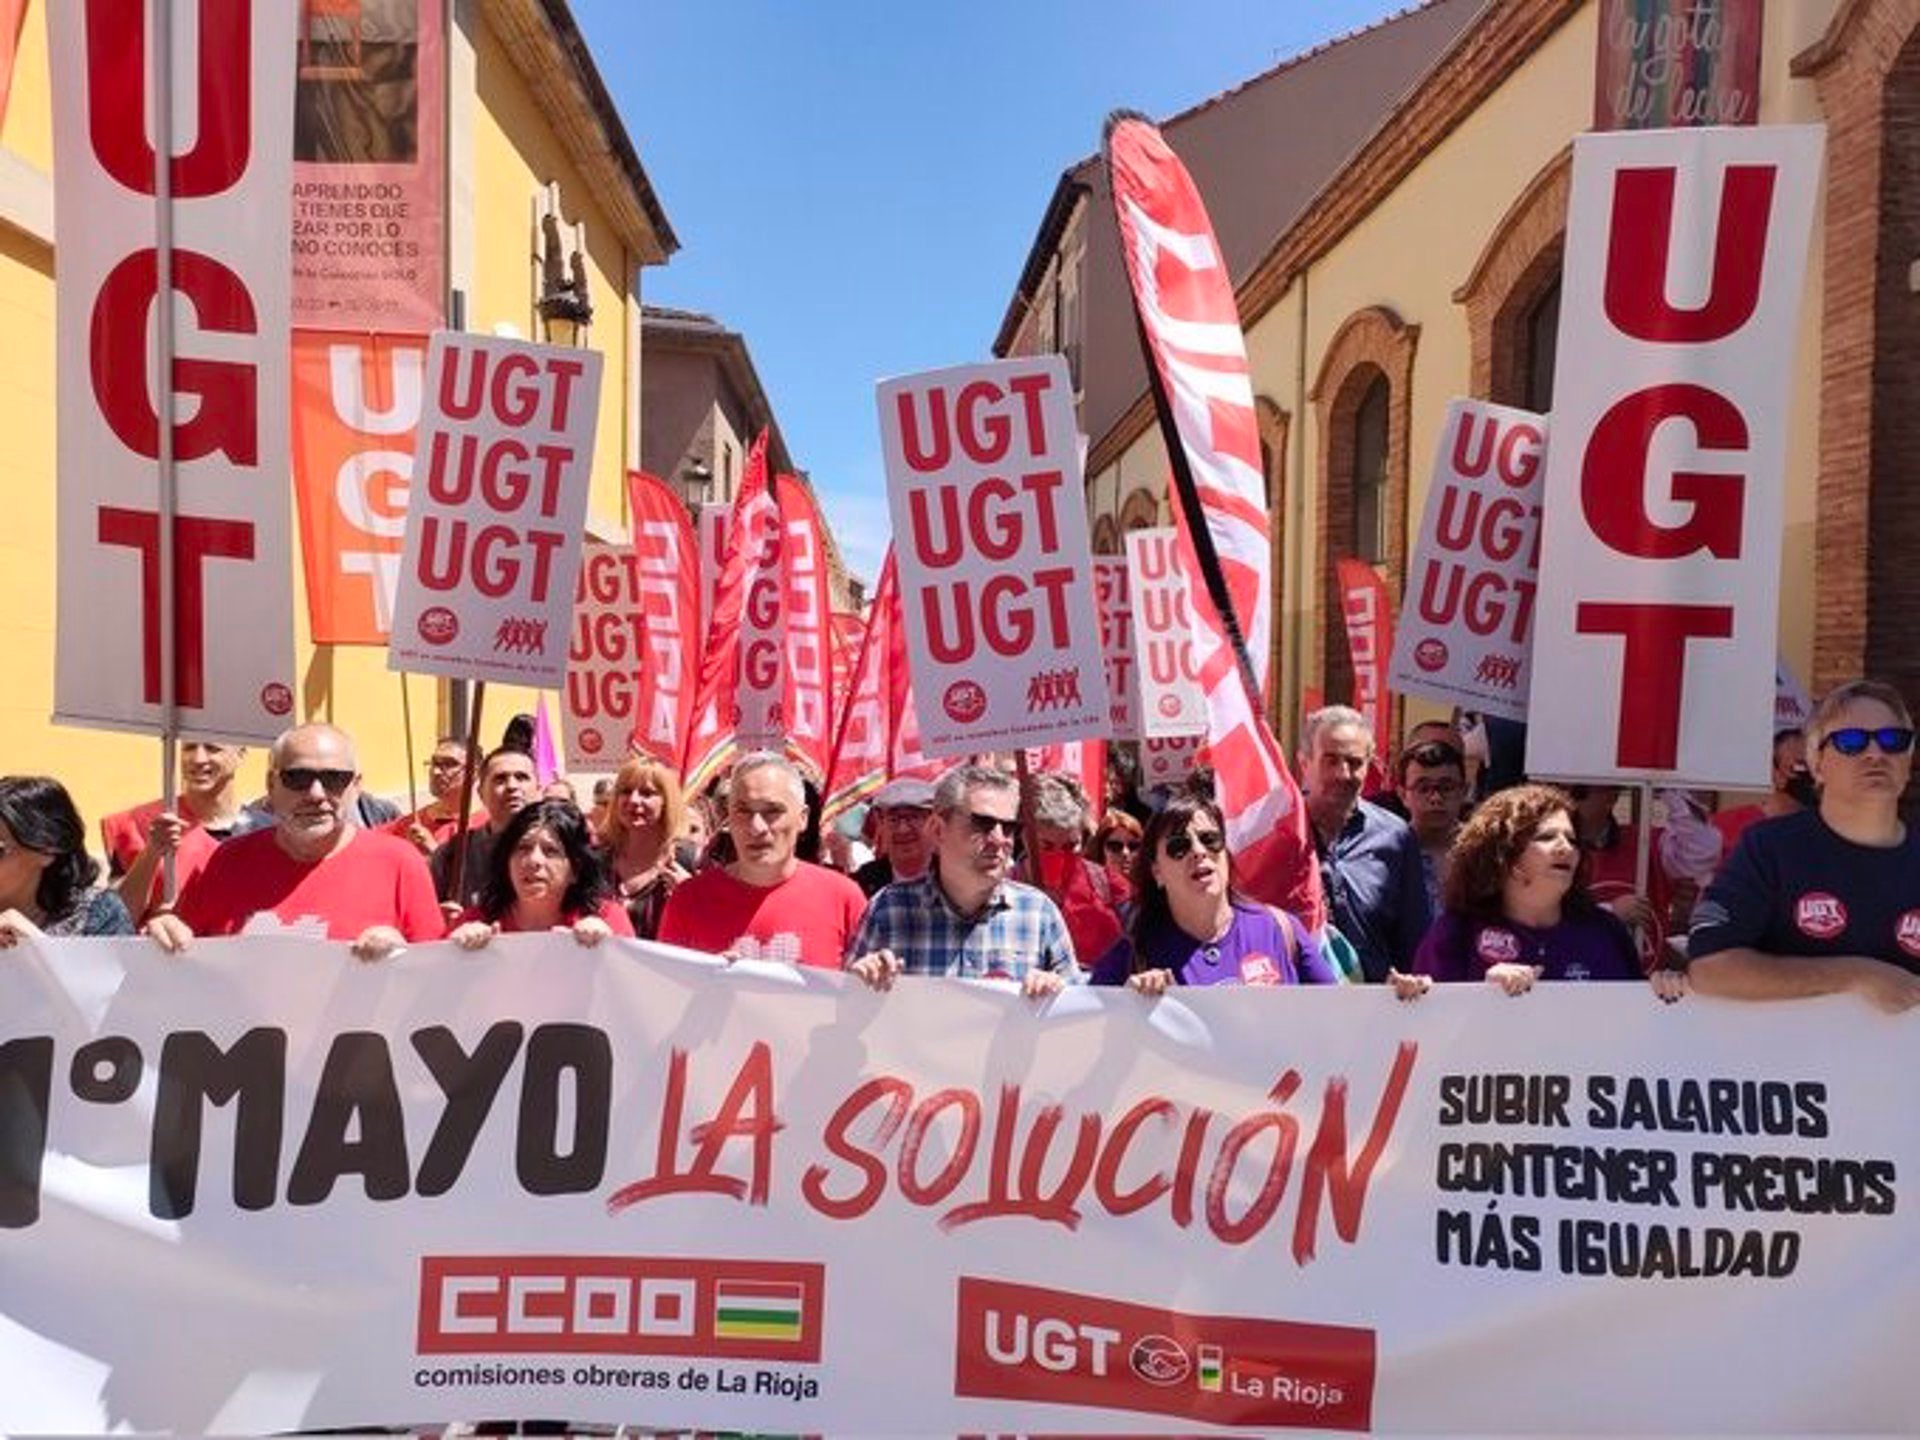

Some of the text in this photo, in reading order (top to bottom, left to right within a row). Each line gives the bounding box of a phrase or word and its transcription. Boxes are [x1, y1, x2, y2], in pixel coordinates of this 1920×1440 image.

[324, 240, 418, 257] CONOCES
[336, 222, 372, 237] POR
[377, 222, 400, 238] LO
[370, 203, 409, 217] QUE
[84, 0, 259, 708] UGT
[437, 346, 583, 432] UGT
[897, 374, 1052, 473] UGT
[1452, 411, 1542, 487] UG
[428, 431, 574, 519] UGT
[1575, 164, 1778, 771] UGT
[417, 516, 566, 603] UGT
[909, 470, 1063, 569] UGT
[921, 567, 1076, 664] UGT
[1439, 1075, 1829, 1138] SUBIR SALARIOS
[606, 1040, 785, 1215] LA
[801, 1038, 1418, 1267] SOLUCIÓN
[1436, 1143, 1897, 1215] CONTENER PRECIOS
[1436, 1200, 1802, 1279] MÁS IGUALDAD
[439, 1274, 696, 1336] CCOO
[414, 1364, 819, 1400] comisiones obreras de La Rioja
[984, 1309, 1343, 1406] UGT La Rioja
